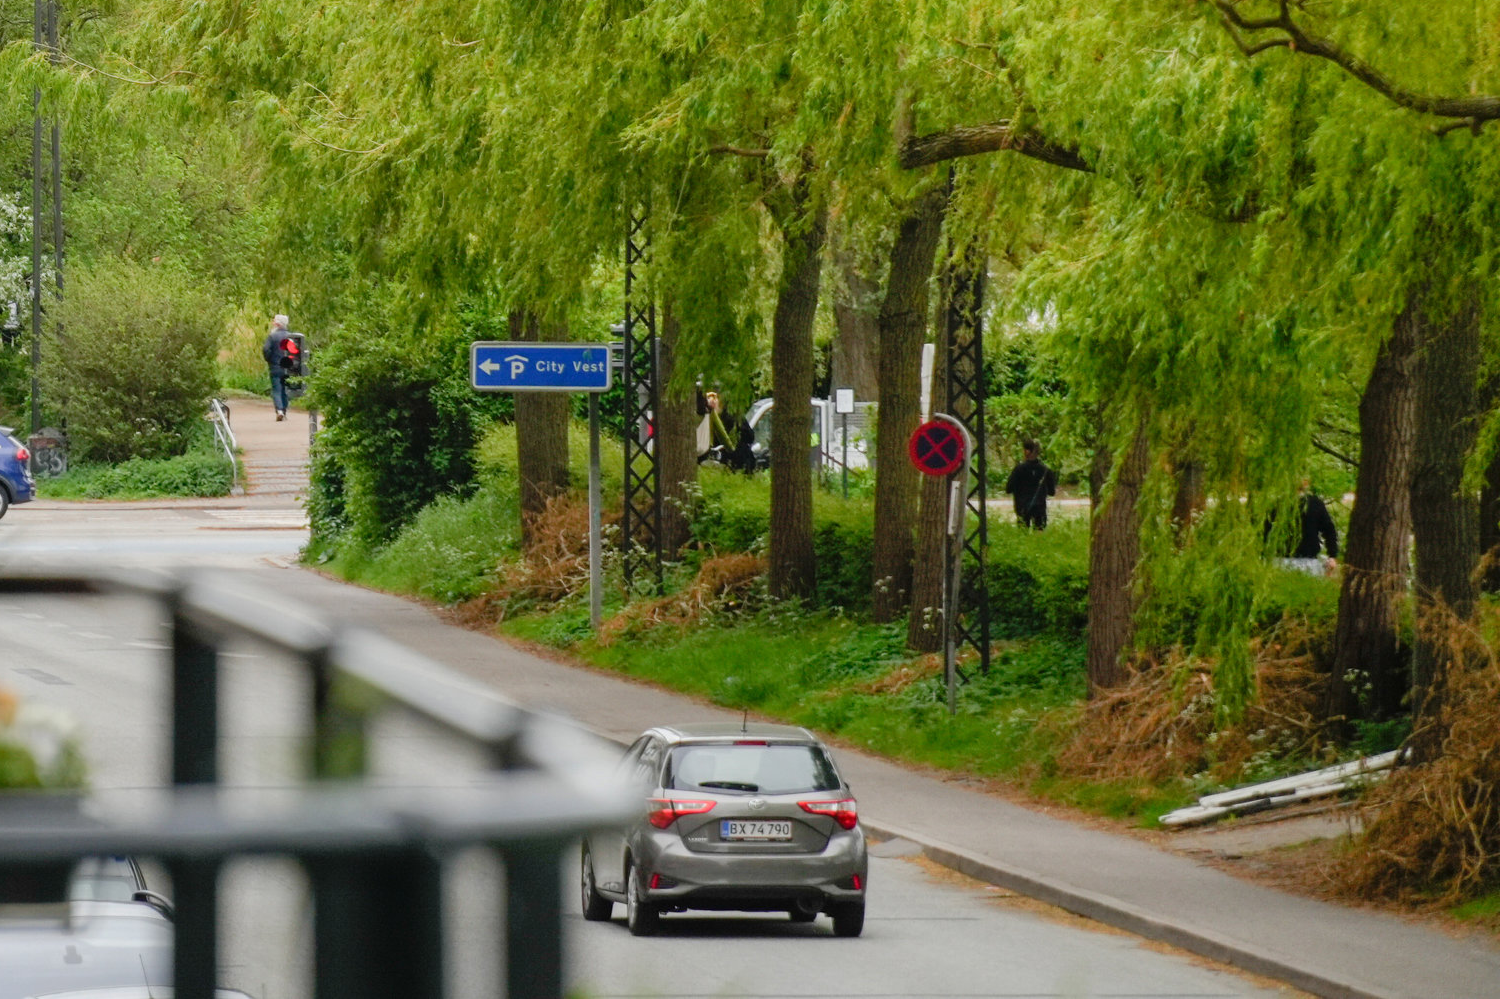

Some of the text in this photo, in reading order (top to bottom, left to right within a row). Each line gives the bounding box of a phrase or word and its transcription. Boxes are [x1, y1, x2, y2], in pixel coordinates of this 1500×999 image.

[511, 360, 605, 380] P City Vest
[730, 823, 790, 835] BX 74 790
